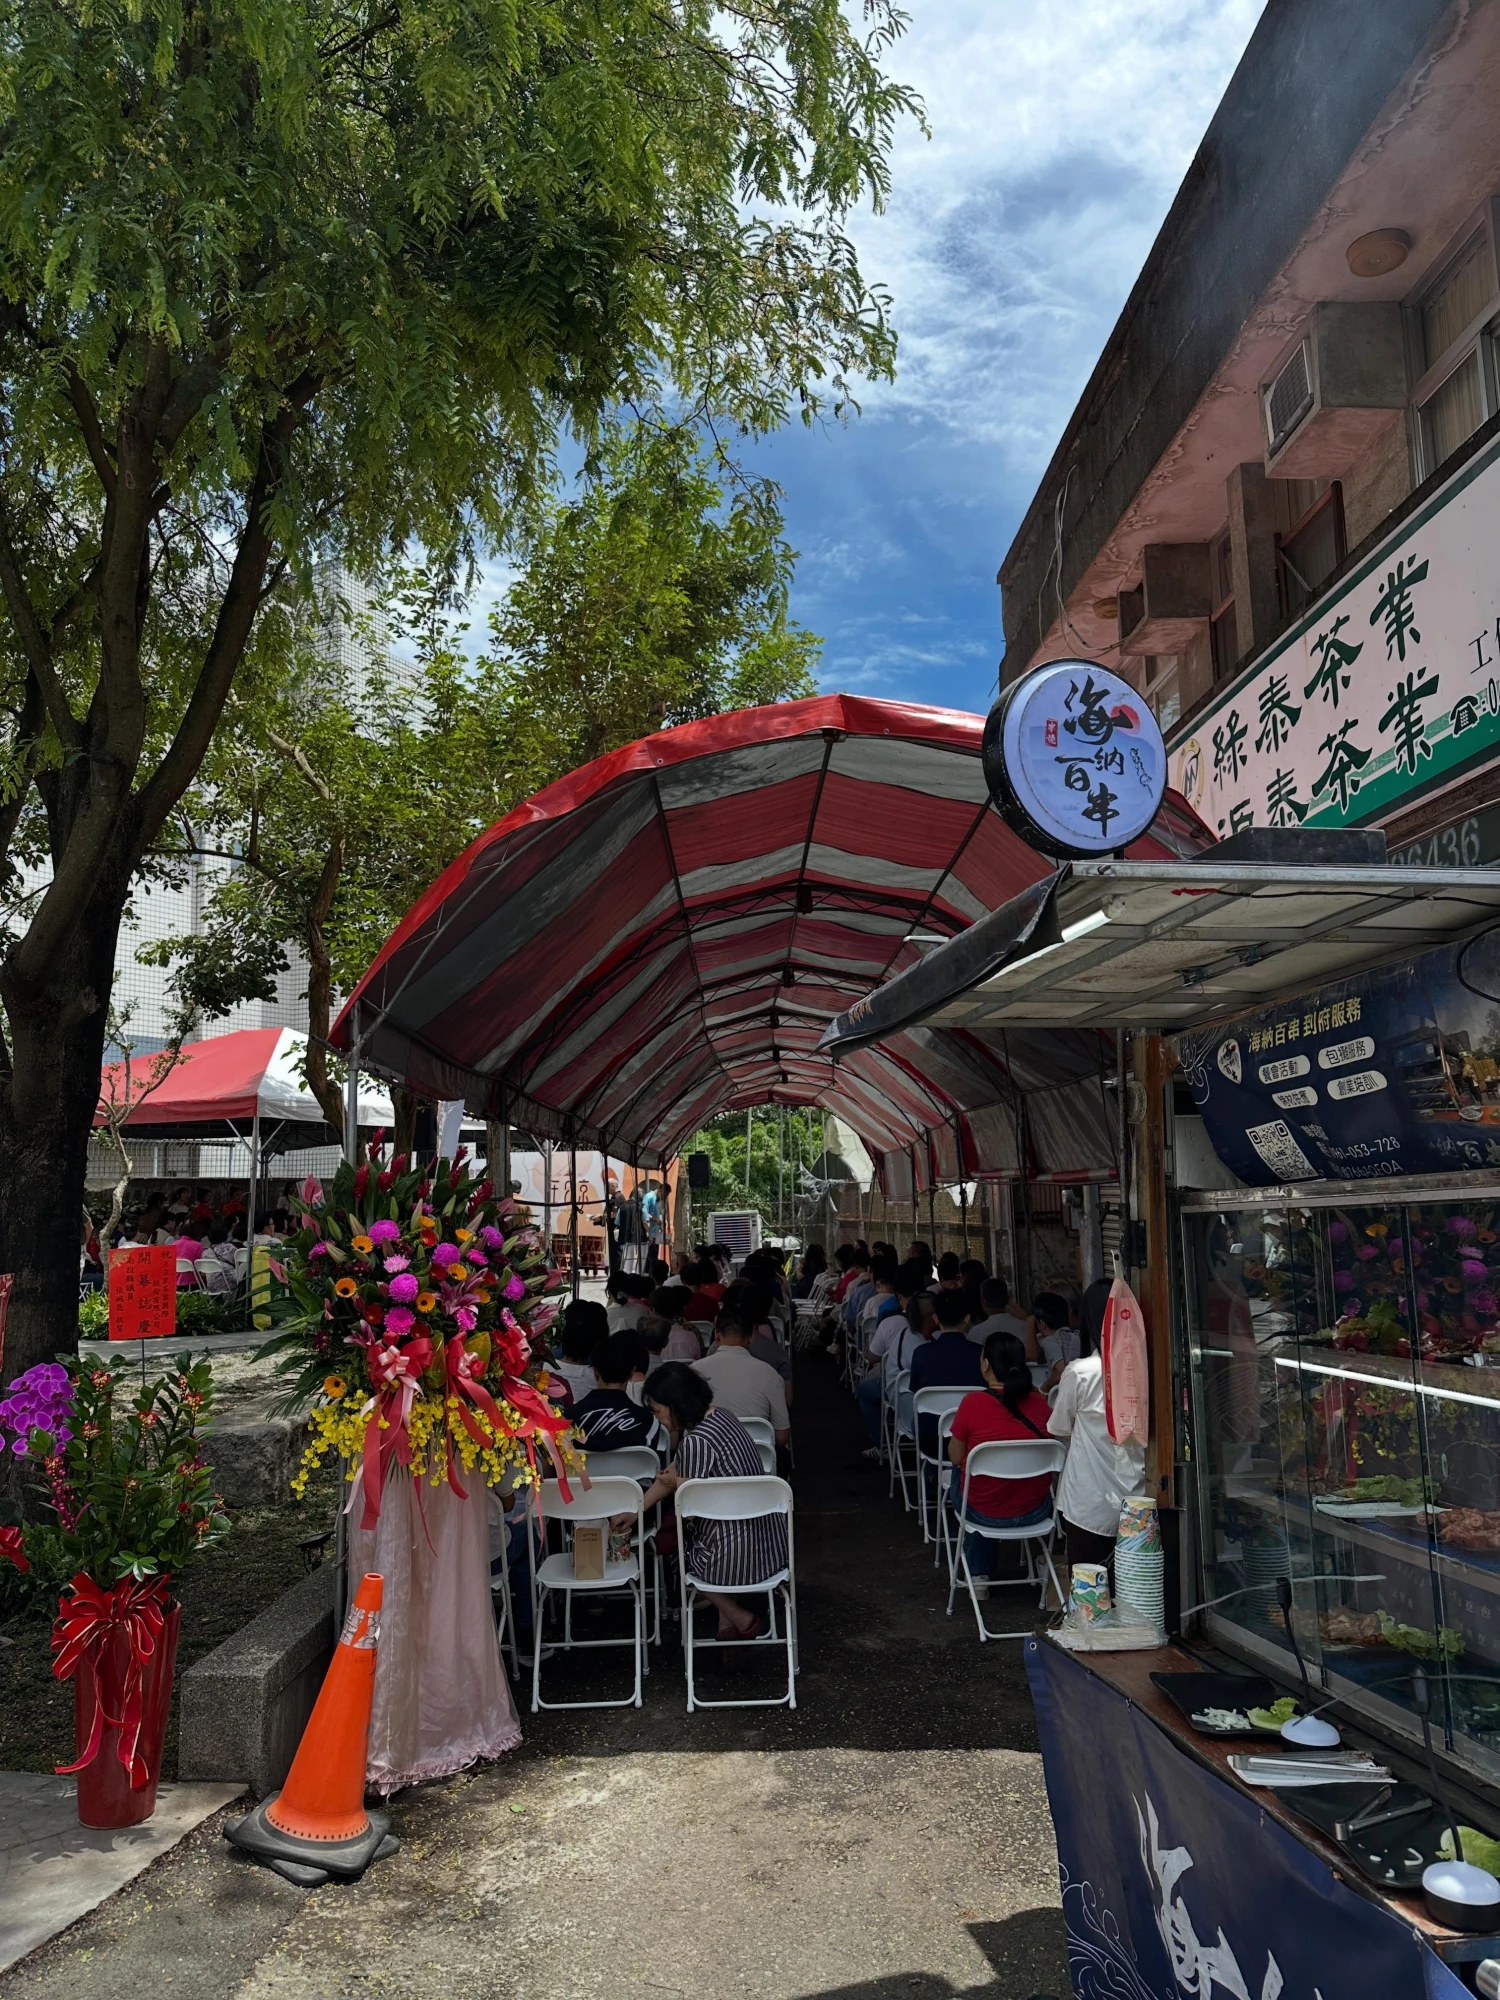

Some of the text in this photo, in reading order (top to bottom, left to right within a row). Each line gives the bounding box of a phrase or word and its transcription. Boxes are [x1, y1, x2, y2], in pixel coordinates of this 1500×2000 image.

[1212, 553, 1430, 791] 綠泰茶業
[1248, 996, 1362, 1053] 海納百串 到府服務
[1325, 1040, 1366, 1065] 包攤服務
[1336, 1073, 1380, 1096] 創業培訓
[126, 1257, 135, 1300] 南投縣議員
[138, 1252, 152, 1333] 開幕誌慶
[578, 1407, 643, 1440] Nike
